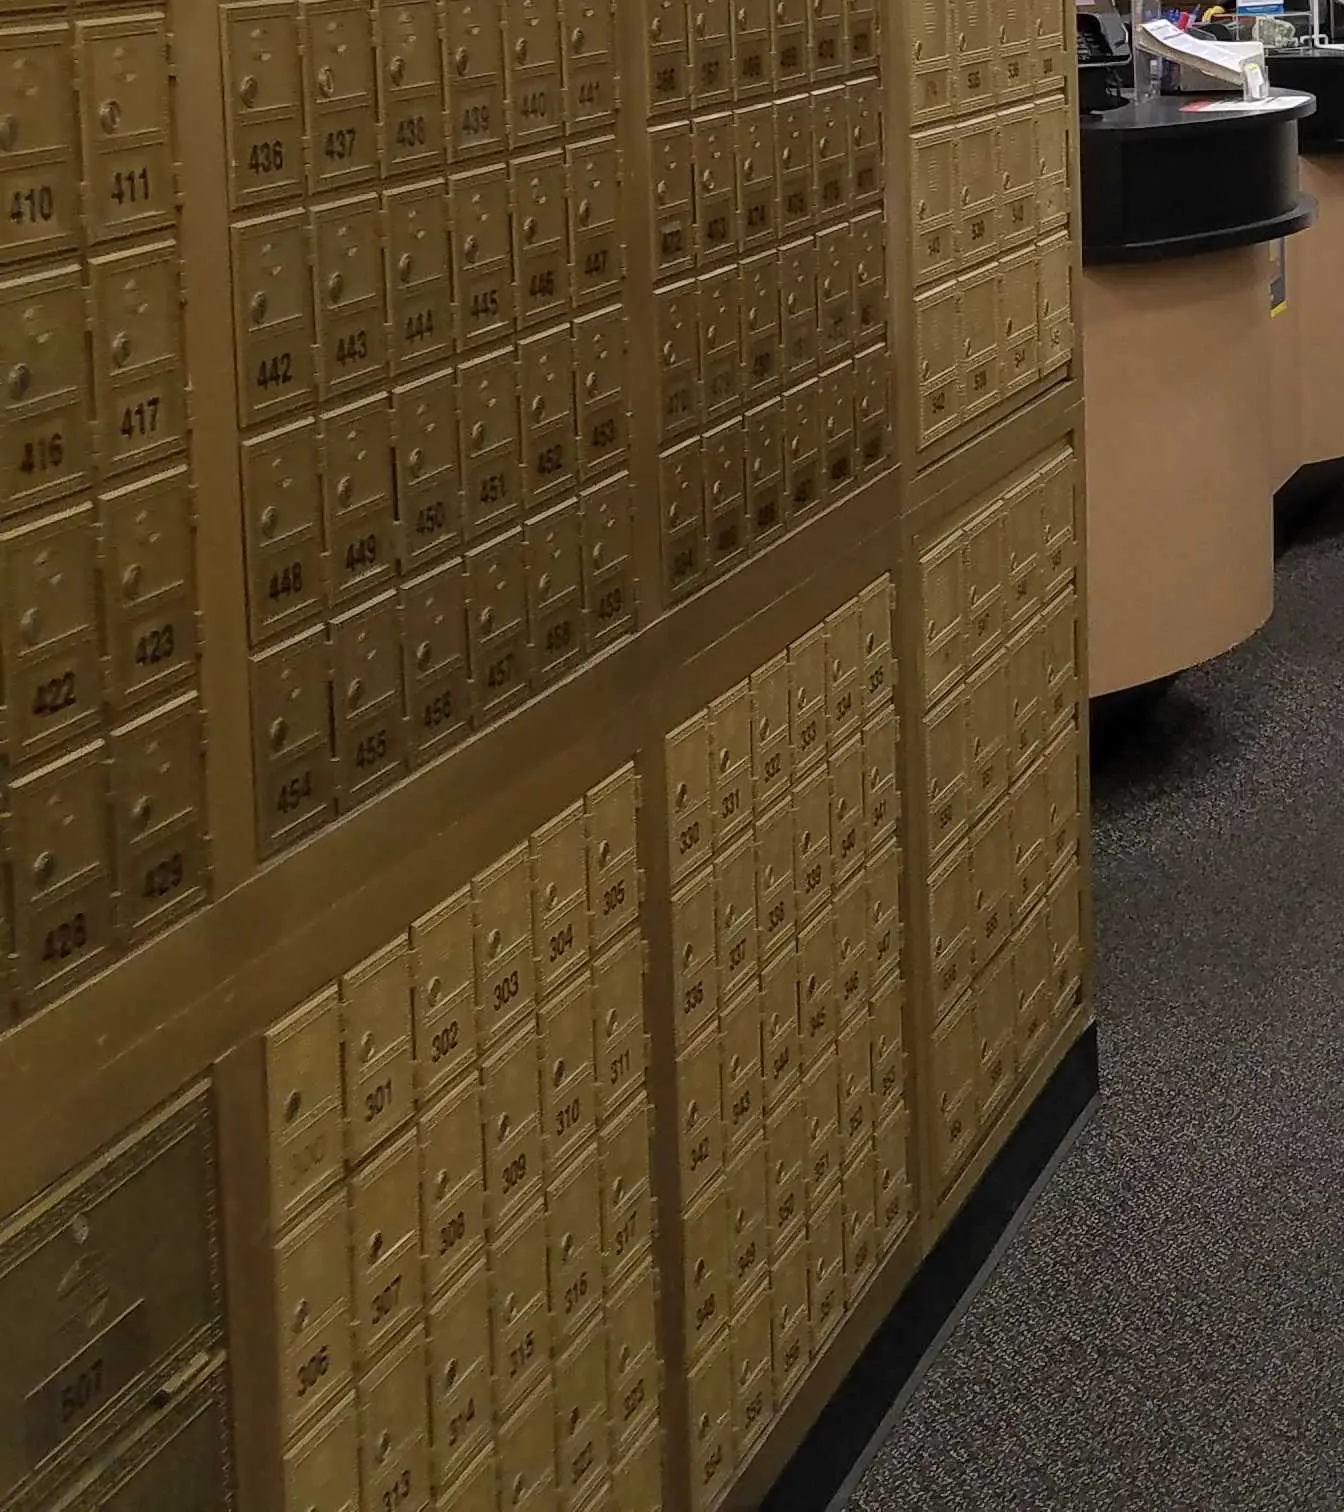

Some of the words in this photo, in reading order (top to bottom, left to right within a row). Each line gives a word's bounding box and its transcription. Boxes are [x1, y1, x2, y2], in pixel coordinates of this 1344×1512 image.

[461, 104, 490, 135] 439
[520, 91, 546, 118] 440
[324, 128, 357, 160] 437
[396, 116, 426, 147] 438
[248, 139, 284, 175] 436
[10, 185, 54, 224] 410
[110, 166, 150, 205] 411
[584, 250, 609, 276] 447
[470, 289, 498, 318] 445
[405, 309, 434, 342] 444
[336, 330, 368, 366] 443
[257, 352, 294, 390] 442
[119, 397, 160, 440] 417
[20, 433, 64, 475] 416
[345, 533, 376, 571] 449
[135, 623, 174, 666] 423
[32, 670, 77, 716] 422
[424, 690, 452, 727] 456
[836, 691, 853, 721] 334
[355, 729, 387, 769] 455
[800, 720, 818, 752] 333
[764, 752, 782, 783] 332
[276, 770, 312, 814] 454
[722, 788, 740, 819] 331
[679, 821, 700, 856] 330
[603, 879, 626, 916] 305
[550, 924, 574, 963] 304
[729, 937, 747, 970] 337
[493, 970, 520, 1011] 303
[431, 1020, 459, 1063] 302
[610, 1050, 632, 1085] 311
[366, 1079, 393, 1123] 301
[556, 1098, 581, 1136] 310
[502, 1153, 527, 1194] 309
[616, 1210, 638, 1255] 317
[372, 1274, 402, 1324] 307
[565, 1271, 589, 1314] 316
[510, 1330, 535, 1378] 315
